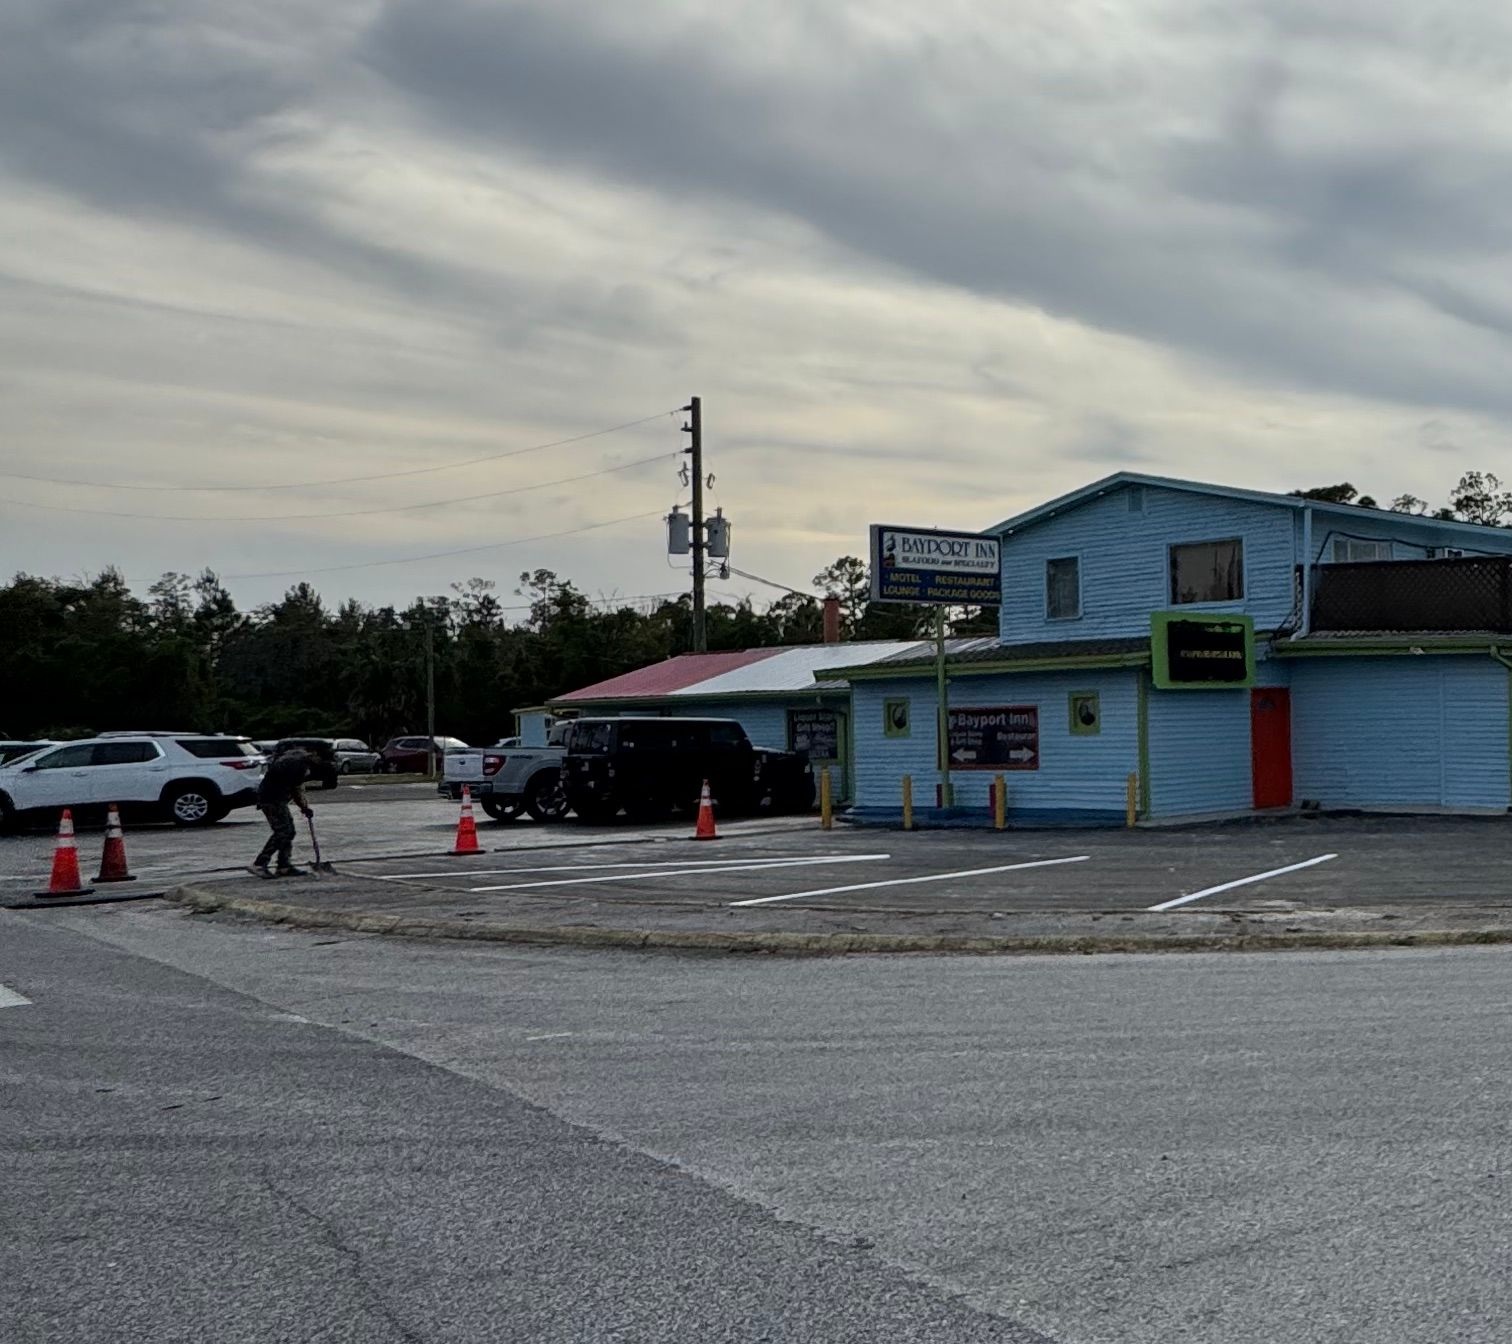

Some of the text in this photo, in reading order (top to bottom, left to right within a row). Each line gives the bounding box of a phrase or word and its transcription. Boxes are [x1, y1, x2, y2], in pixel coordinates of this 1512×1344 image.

[902, 537, 996, 559] BAYPORT INN
[889, 572, 994, 586] MOTEL RESTAURANT
[883, 585, 920, 596] LOUNGE
[927, 587, 968, 599] PACKAGE
[958, 712, 1029, 729] Bayport Inn
